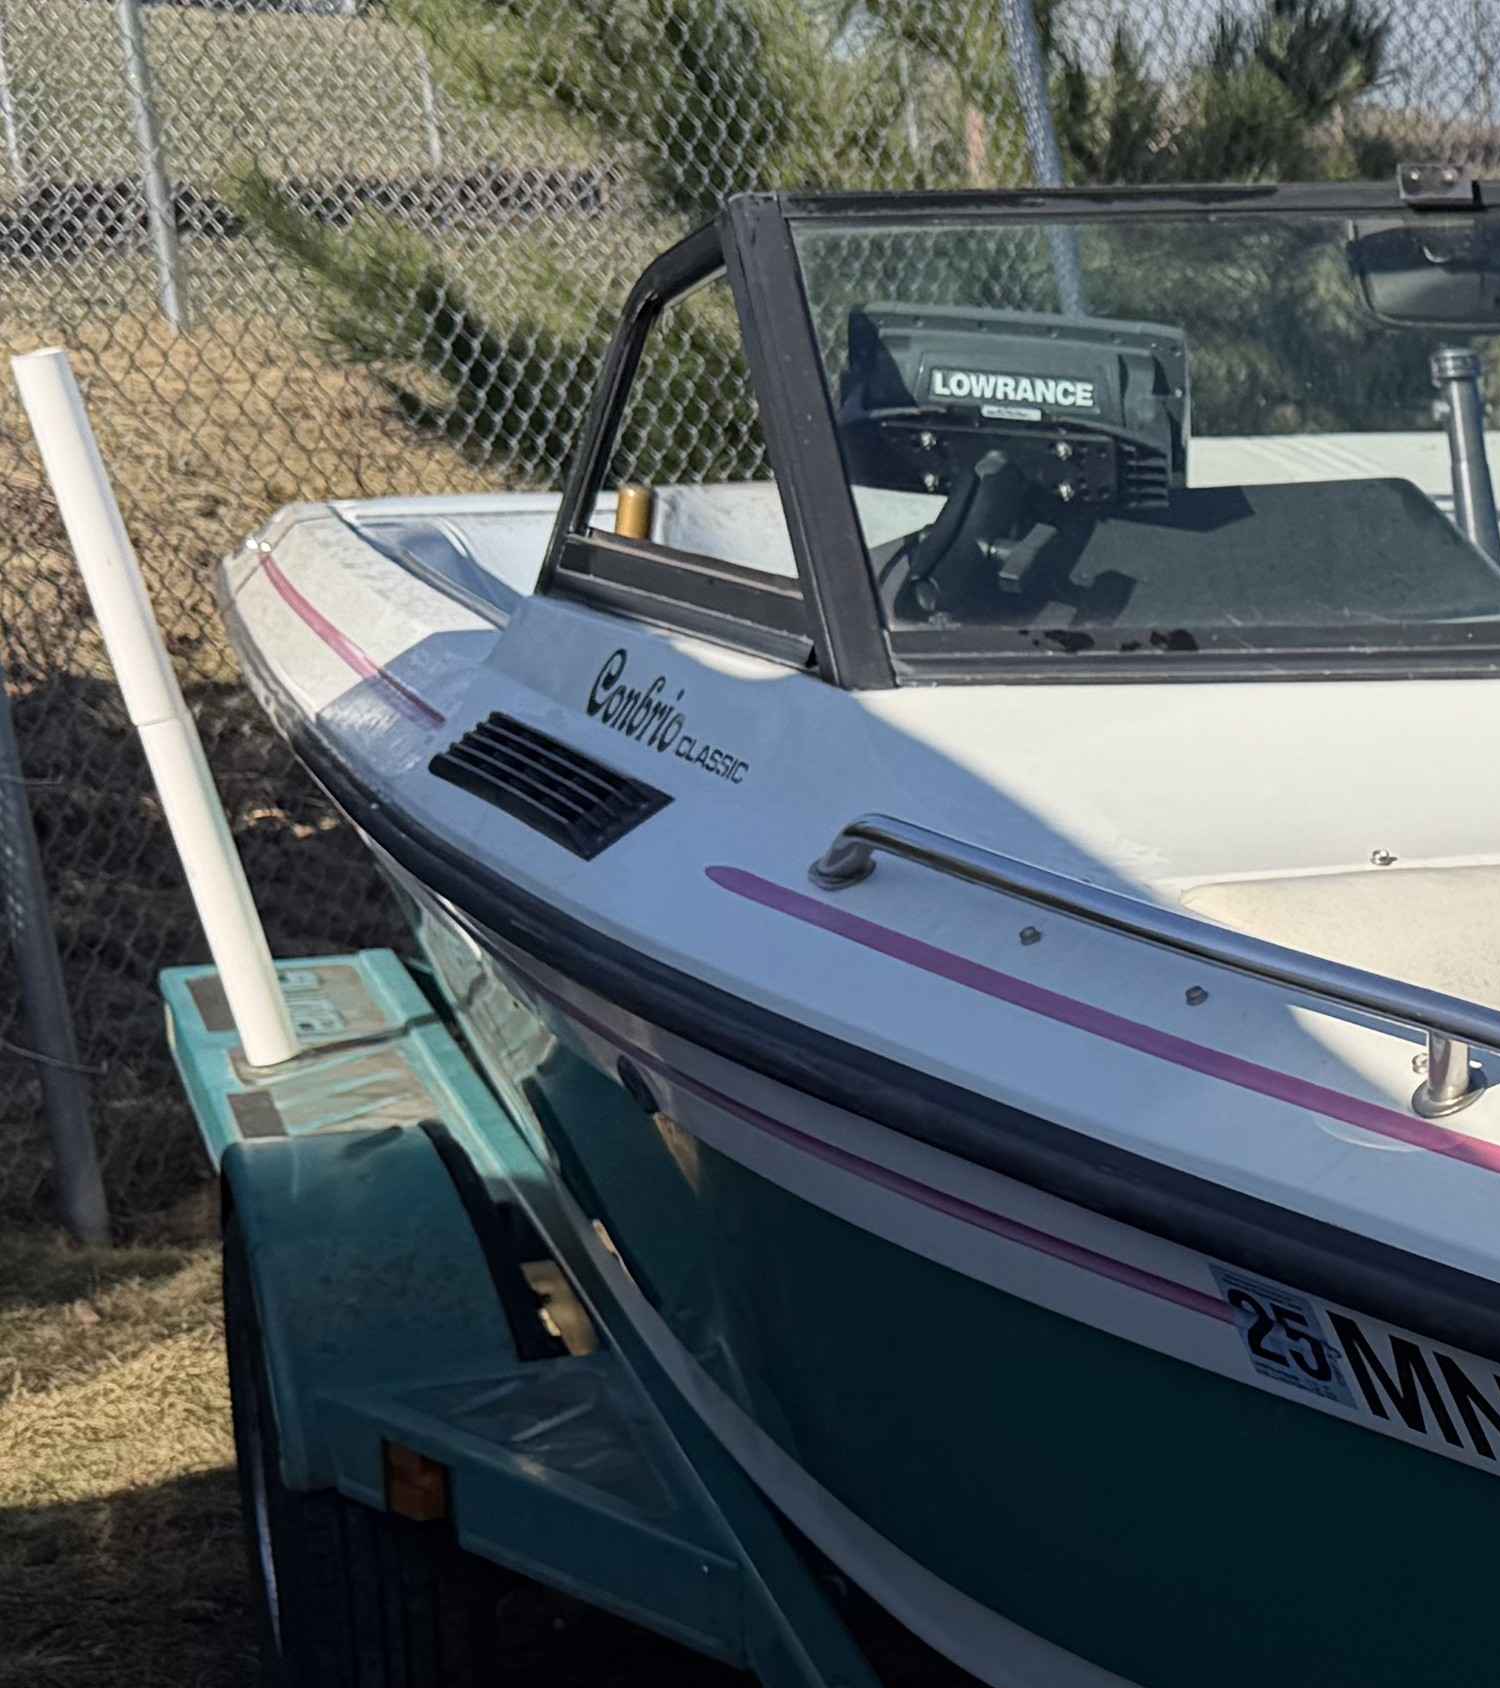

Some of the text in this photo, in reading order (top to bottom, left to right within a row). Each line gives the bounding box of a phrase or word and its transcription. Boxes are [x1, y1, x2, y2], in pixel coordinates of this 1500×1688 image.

[932, 369, 1094, 407] LOWRANCE
[586, 648, 749, 784] Conbrio CLASSIC
[1227, 1288, 1331, 1381] 25
